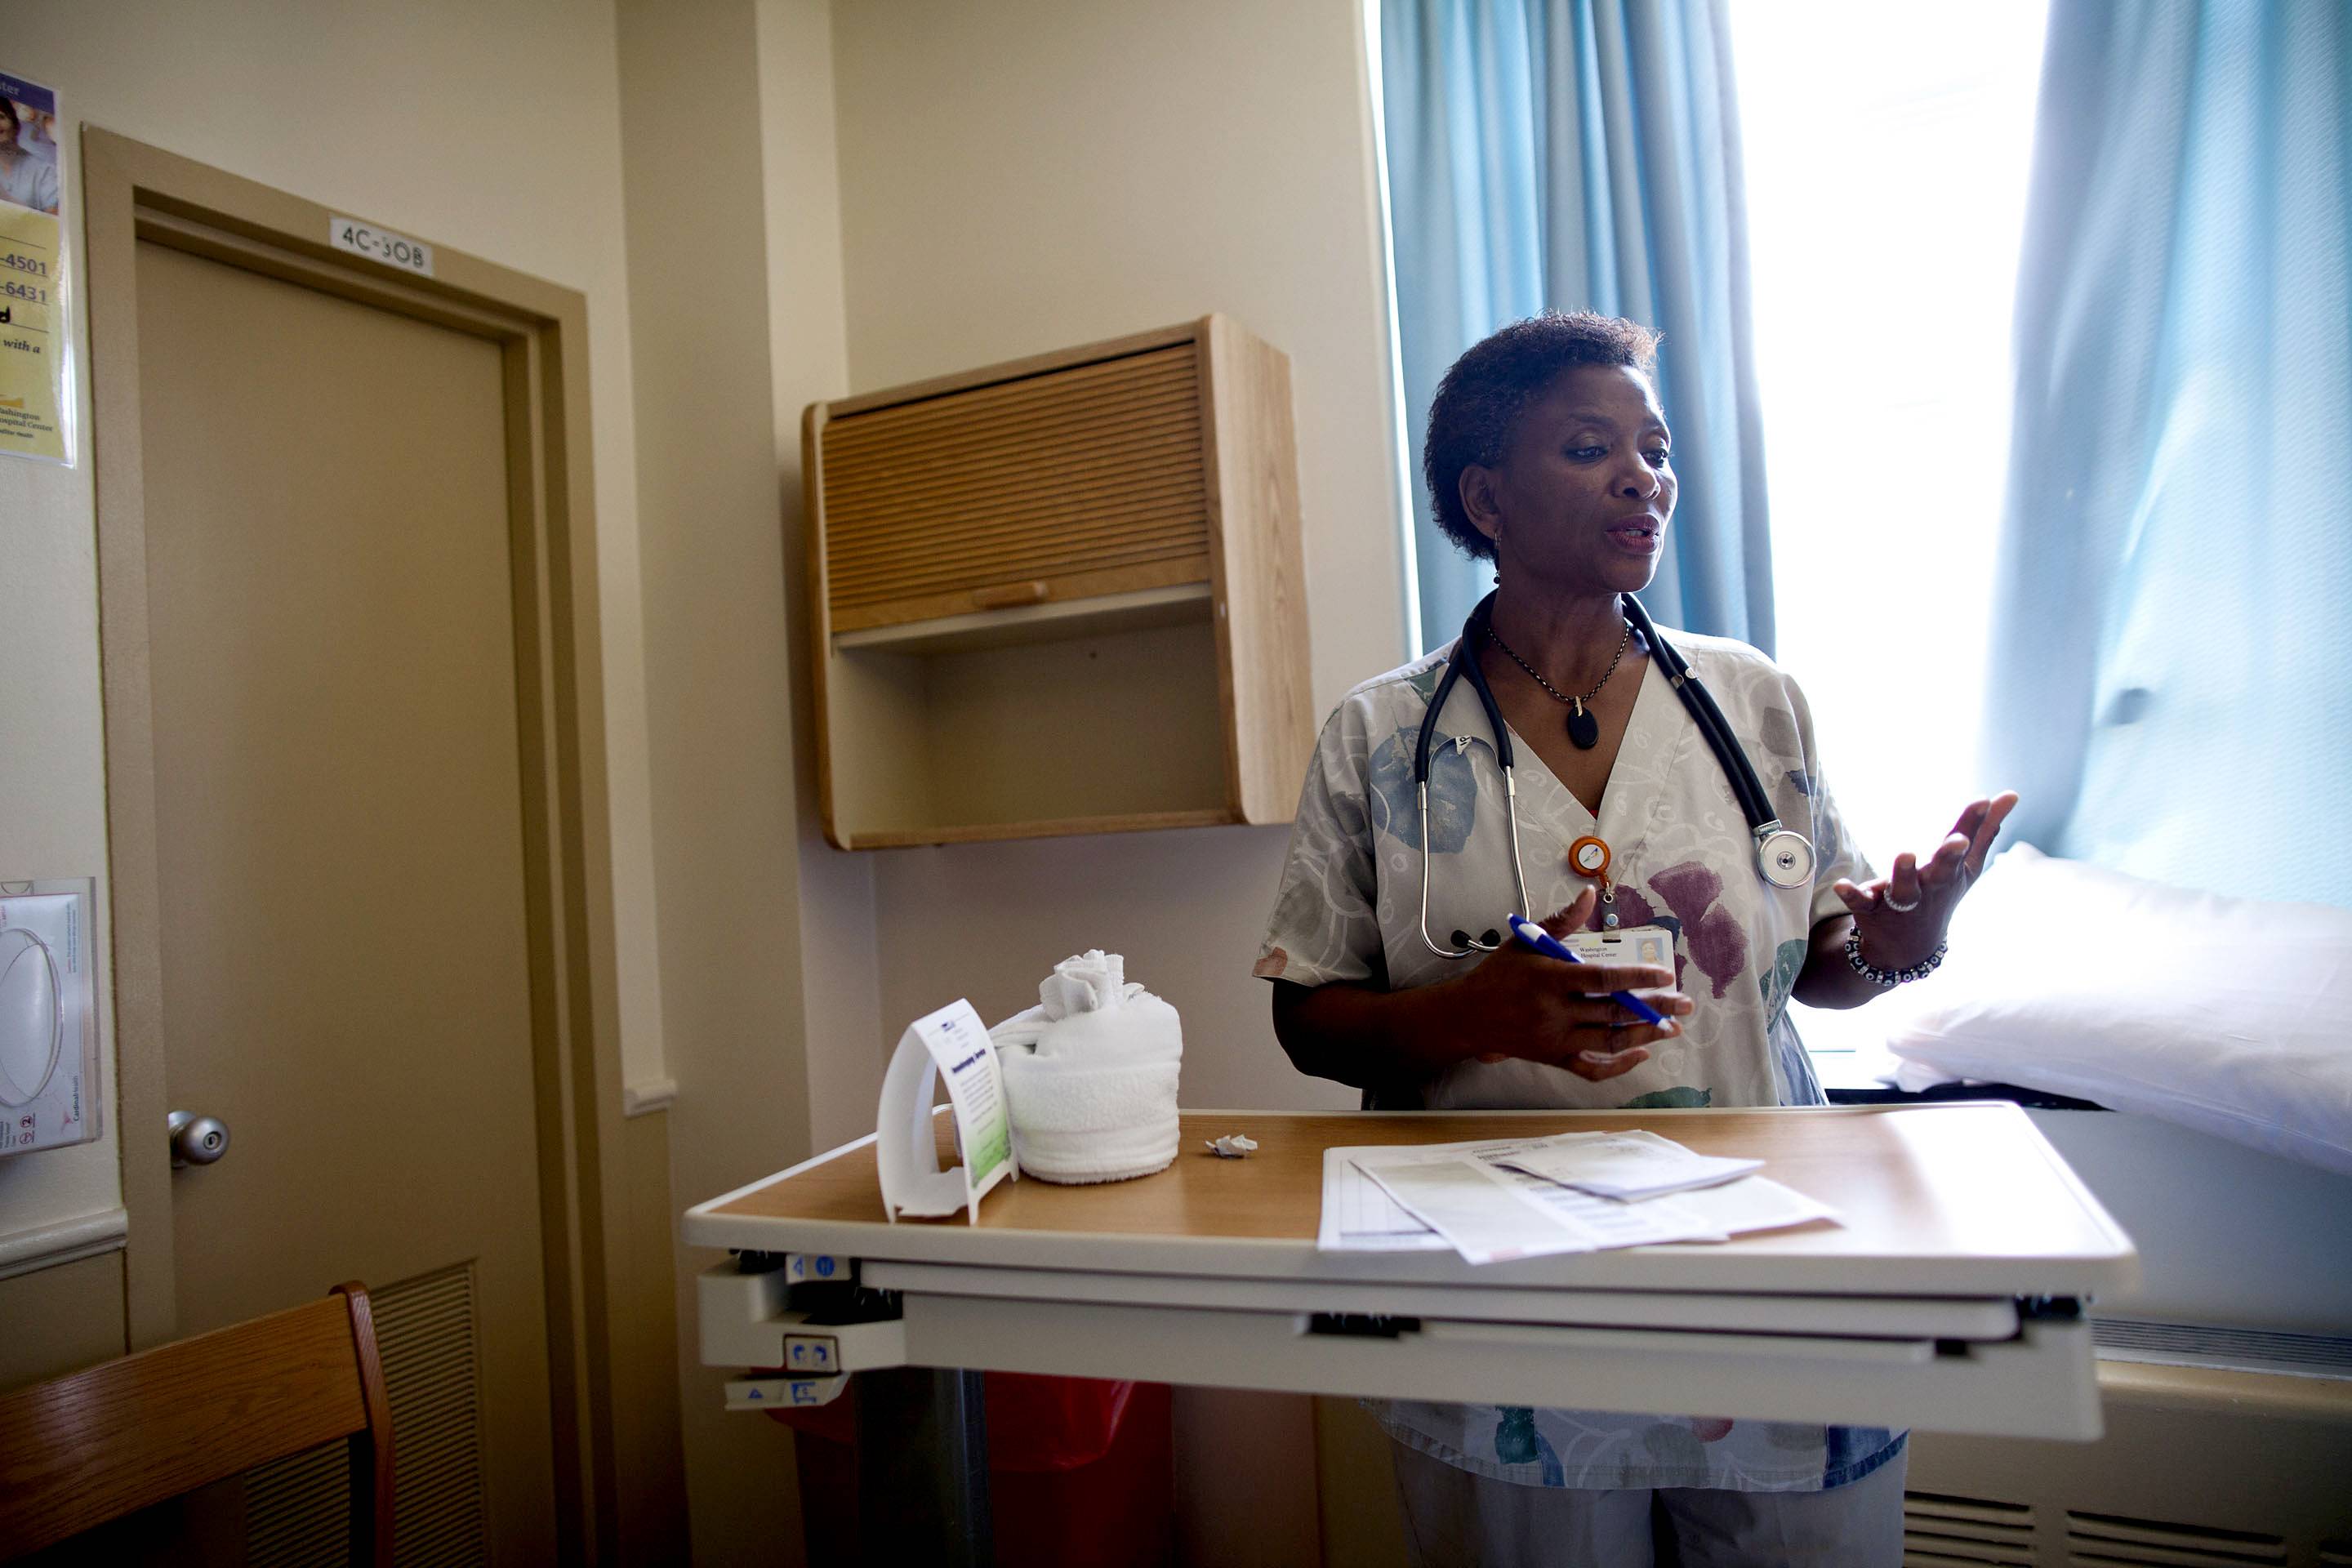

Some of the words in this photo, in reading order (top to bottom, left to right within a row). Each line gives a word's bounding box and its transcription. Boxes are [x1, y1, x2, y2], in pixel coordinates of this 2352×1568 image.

[342, 227, 423, 268] 4C-30B
[3, 339, 29, 351] with
[0, 407, 40, 420] ashington
[27, 421, 53, 431] Center
